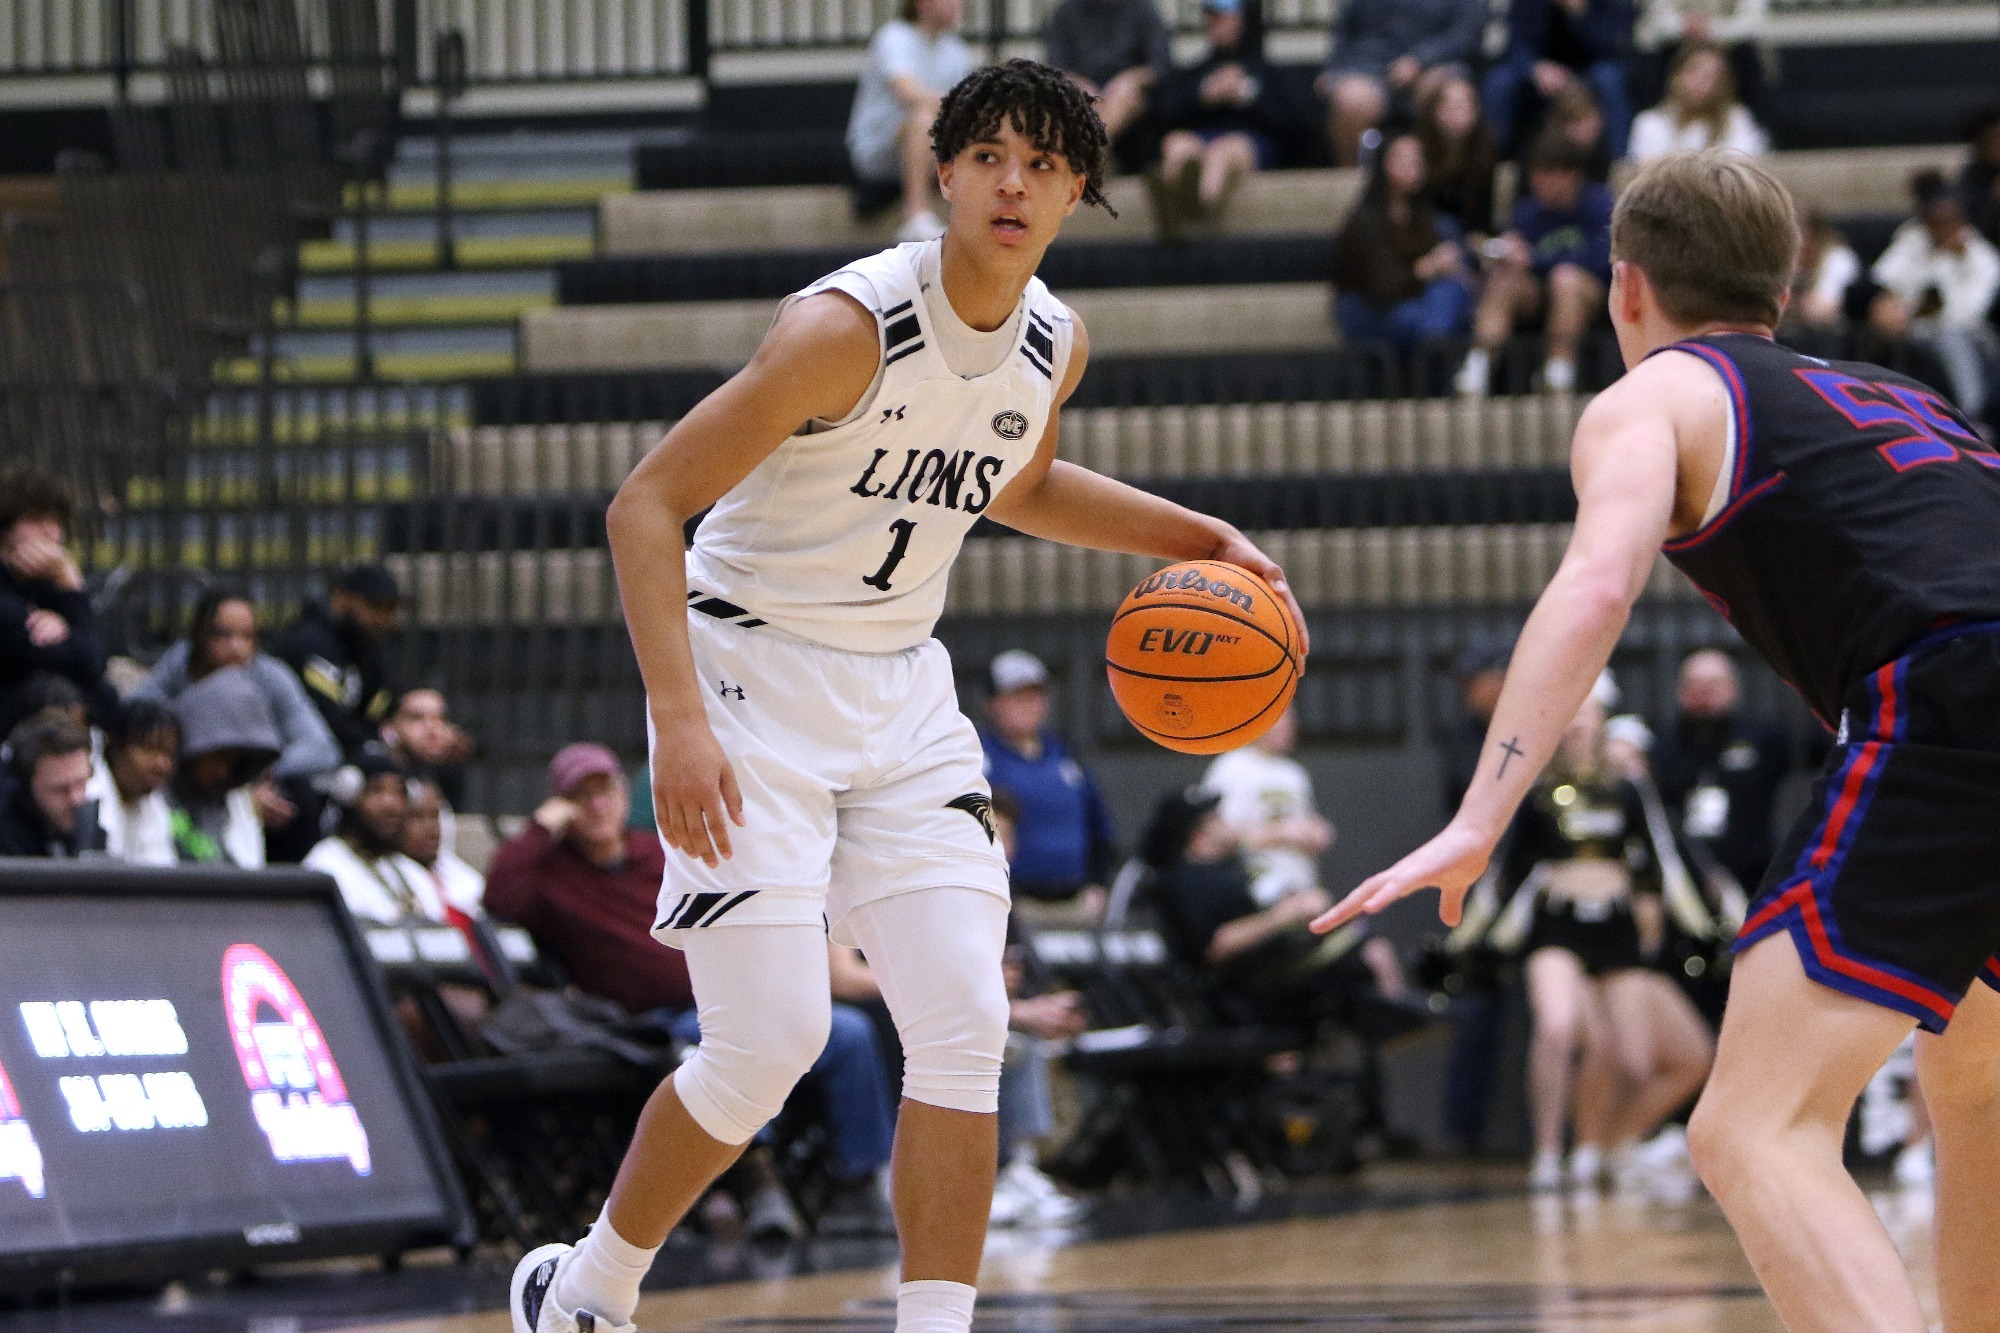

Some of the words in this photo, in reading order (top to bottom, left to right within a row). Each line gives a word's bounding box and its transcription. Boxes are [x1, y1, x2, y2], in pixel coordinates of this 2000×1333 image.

[849, 448, 1004, 515] LIONS
[862, 518, 918, 592] 1
[1134, 568, 1254, 614] Wilson
[1138, 628, 1214, 656] EVO
[1215, 634, 1241, 646] NXT
